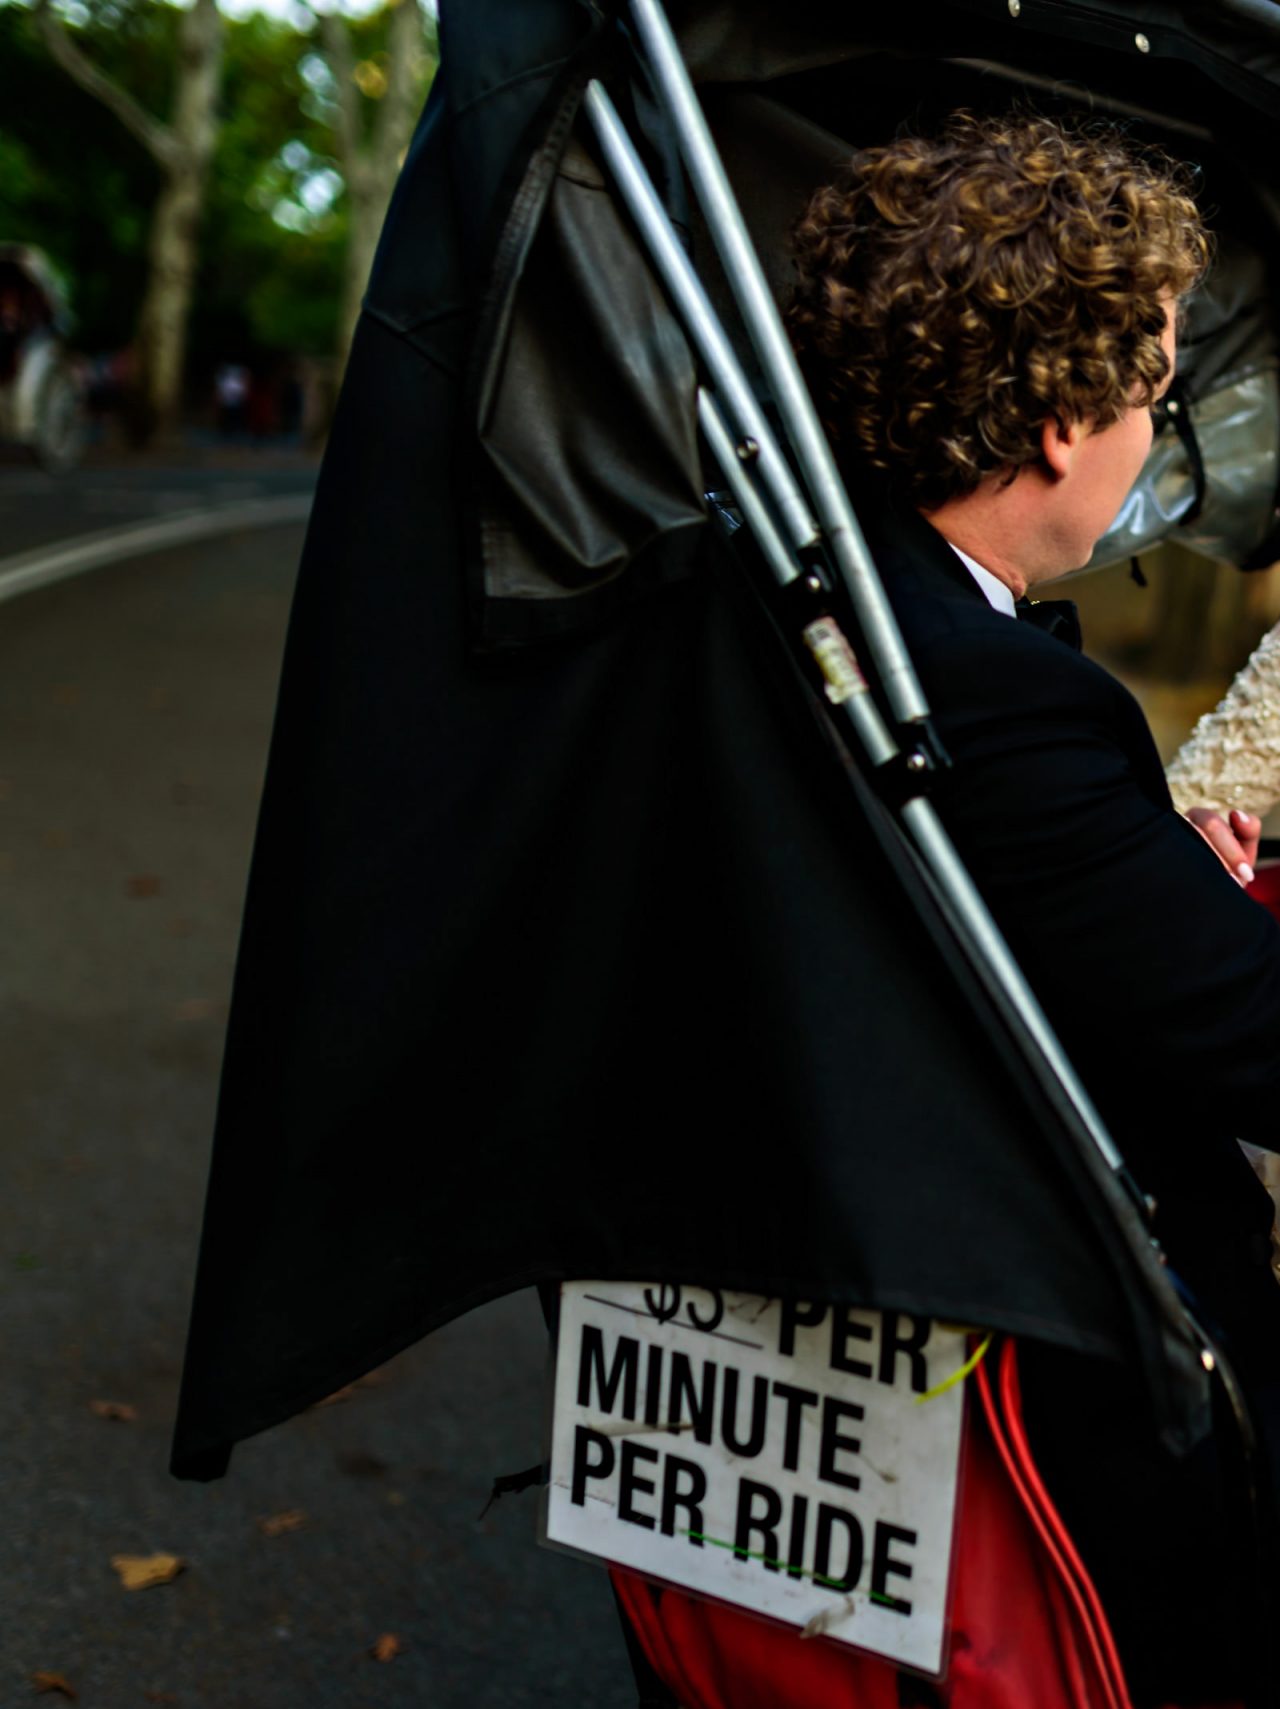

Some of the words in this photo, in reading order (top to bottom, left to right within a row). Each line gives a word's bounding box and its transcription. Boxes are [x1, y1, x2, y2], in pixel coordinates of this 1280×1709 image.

[577, 1323, 866, 1492] MINUTE
[778, 1297, 931, 1394] PER
[571, 1424, 708, 1547] PER
[733, 1477, 918, 1617] RIDE
